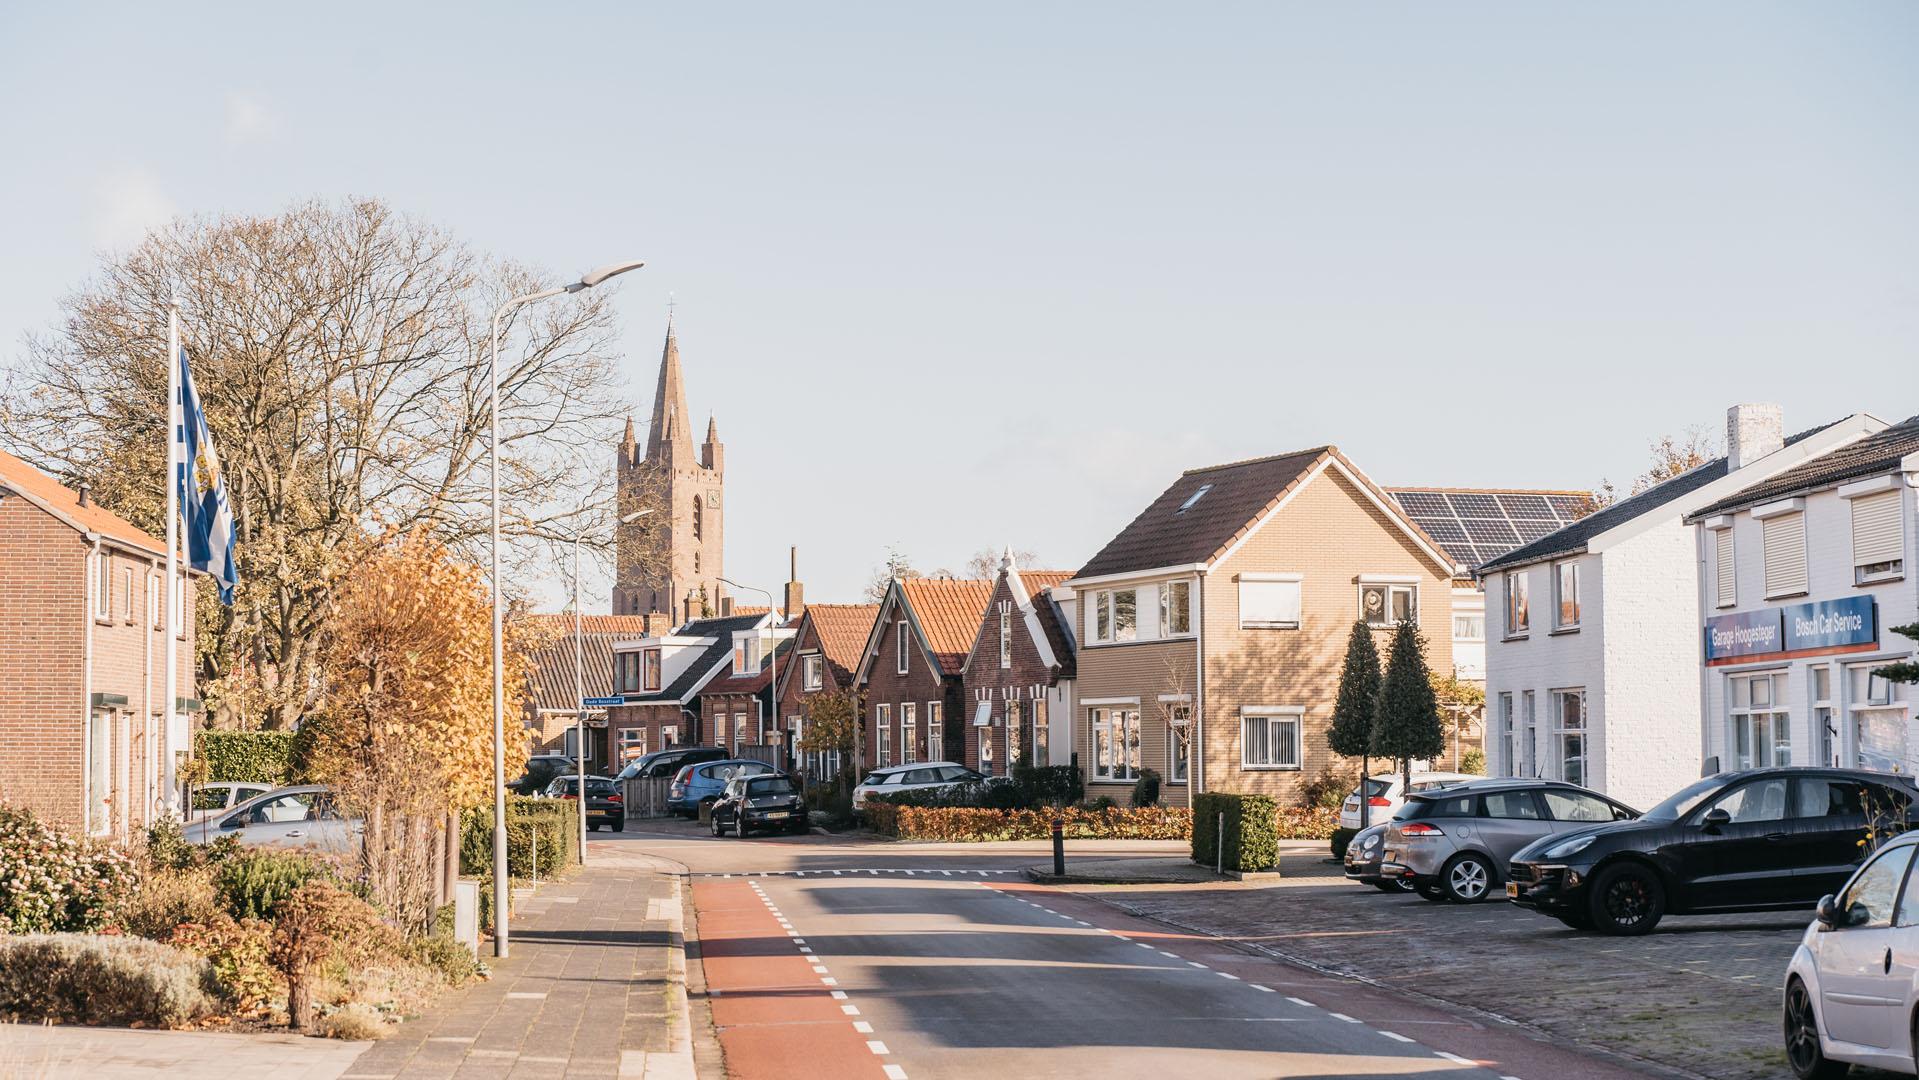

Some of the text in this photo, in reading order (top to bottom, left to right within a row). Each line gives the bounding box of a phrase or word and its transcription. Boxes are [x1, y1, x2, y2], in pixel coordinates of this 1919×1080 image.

[1795, 610, 1862, 637] Bosch Car Service
[1712, 624, 1776, 650] Garage Hoogesteger
